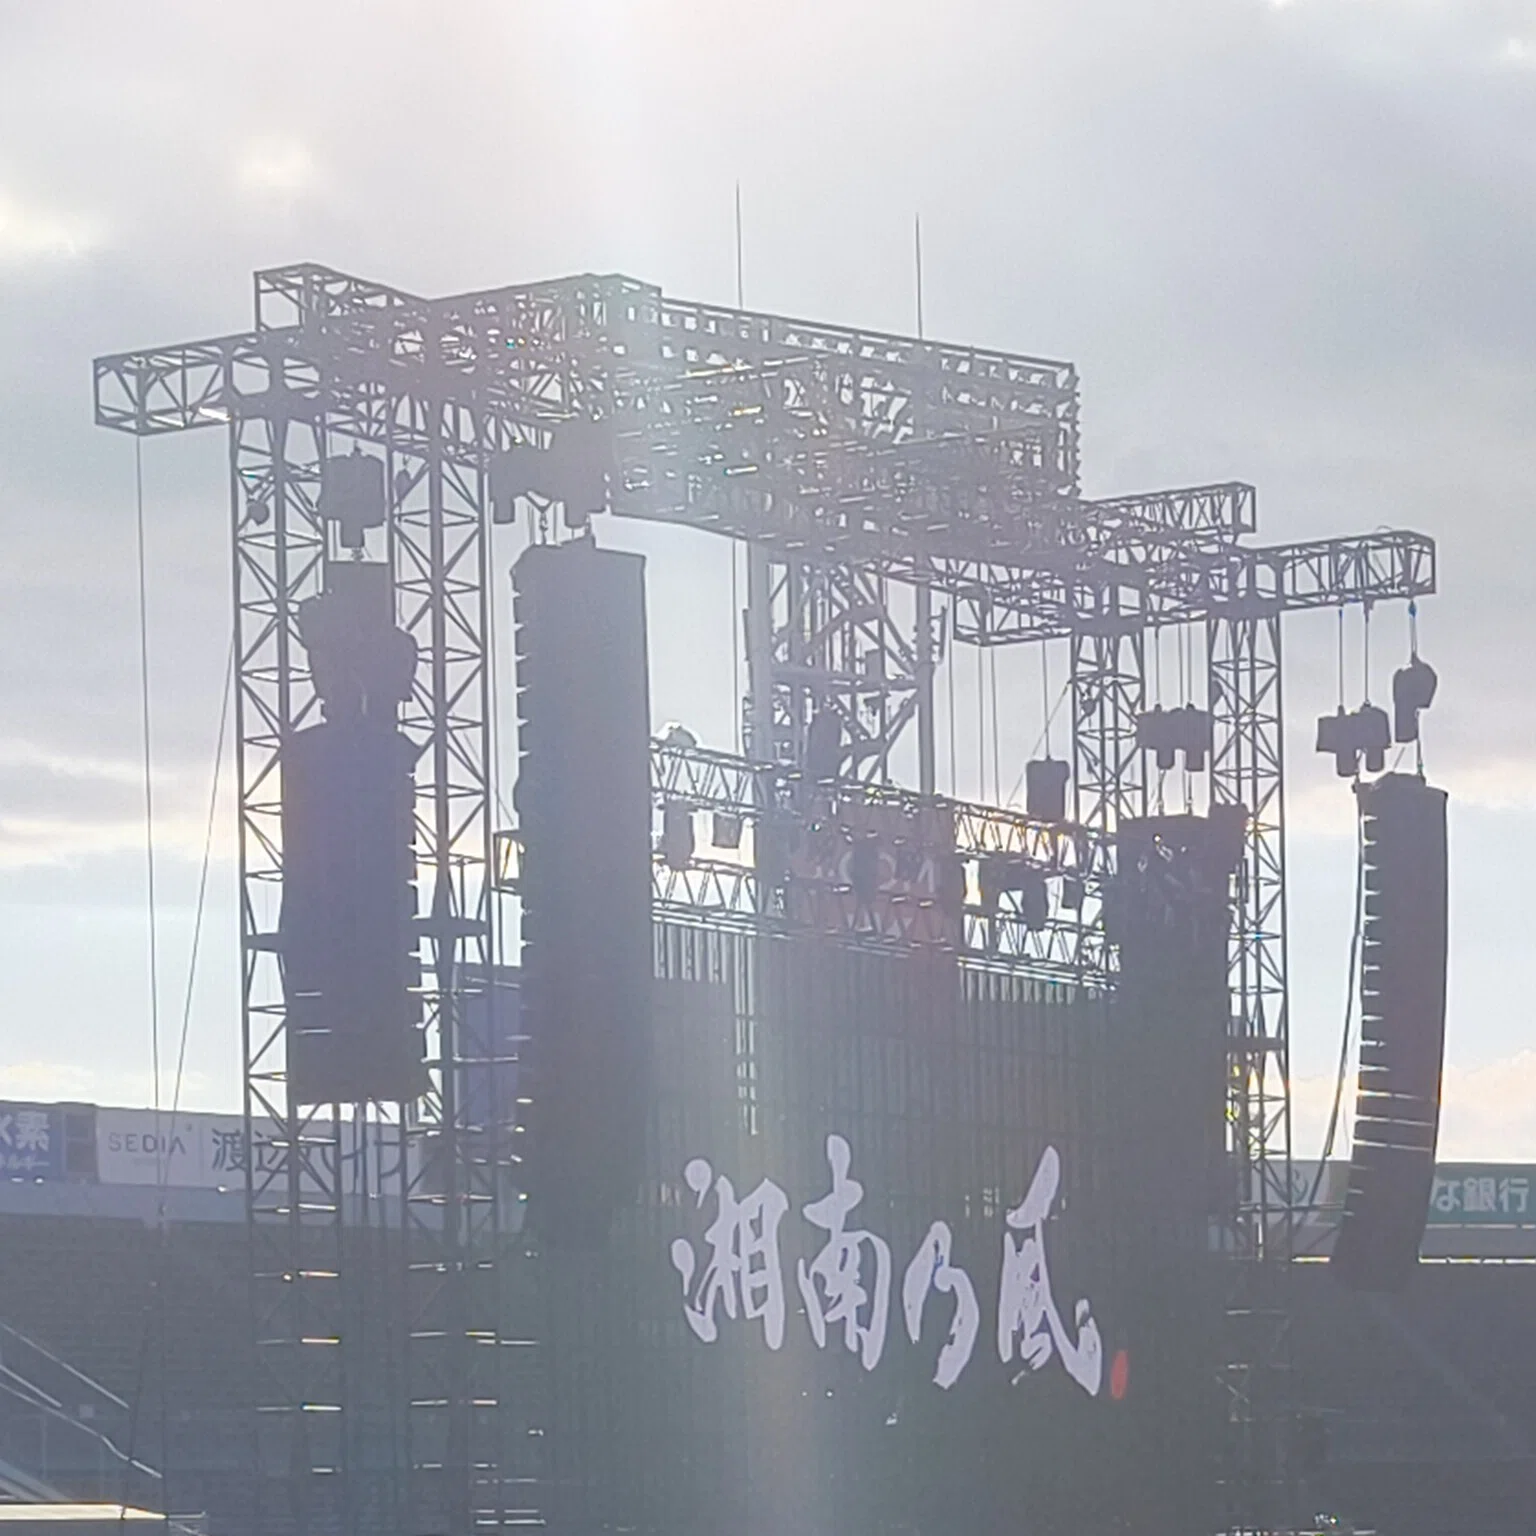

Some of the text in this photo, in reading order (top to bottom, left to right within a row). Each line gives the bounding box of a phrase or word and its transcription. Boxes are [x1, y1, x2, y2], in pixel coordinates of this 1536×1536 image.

[108, 1132, 187, 1154] SEDIA
[671, 1134, 1102, 1397] 湘南乃風
